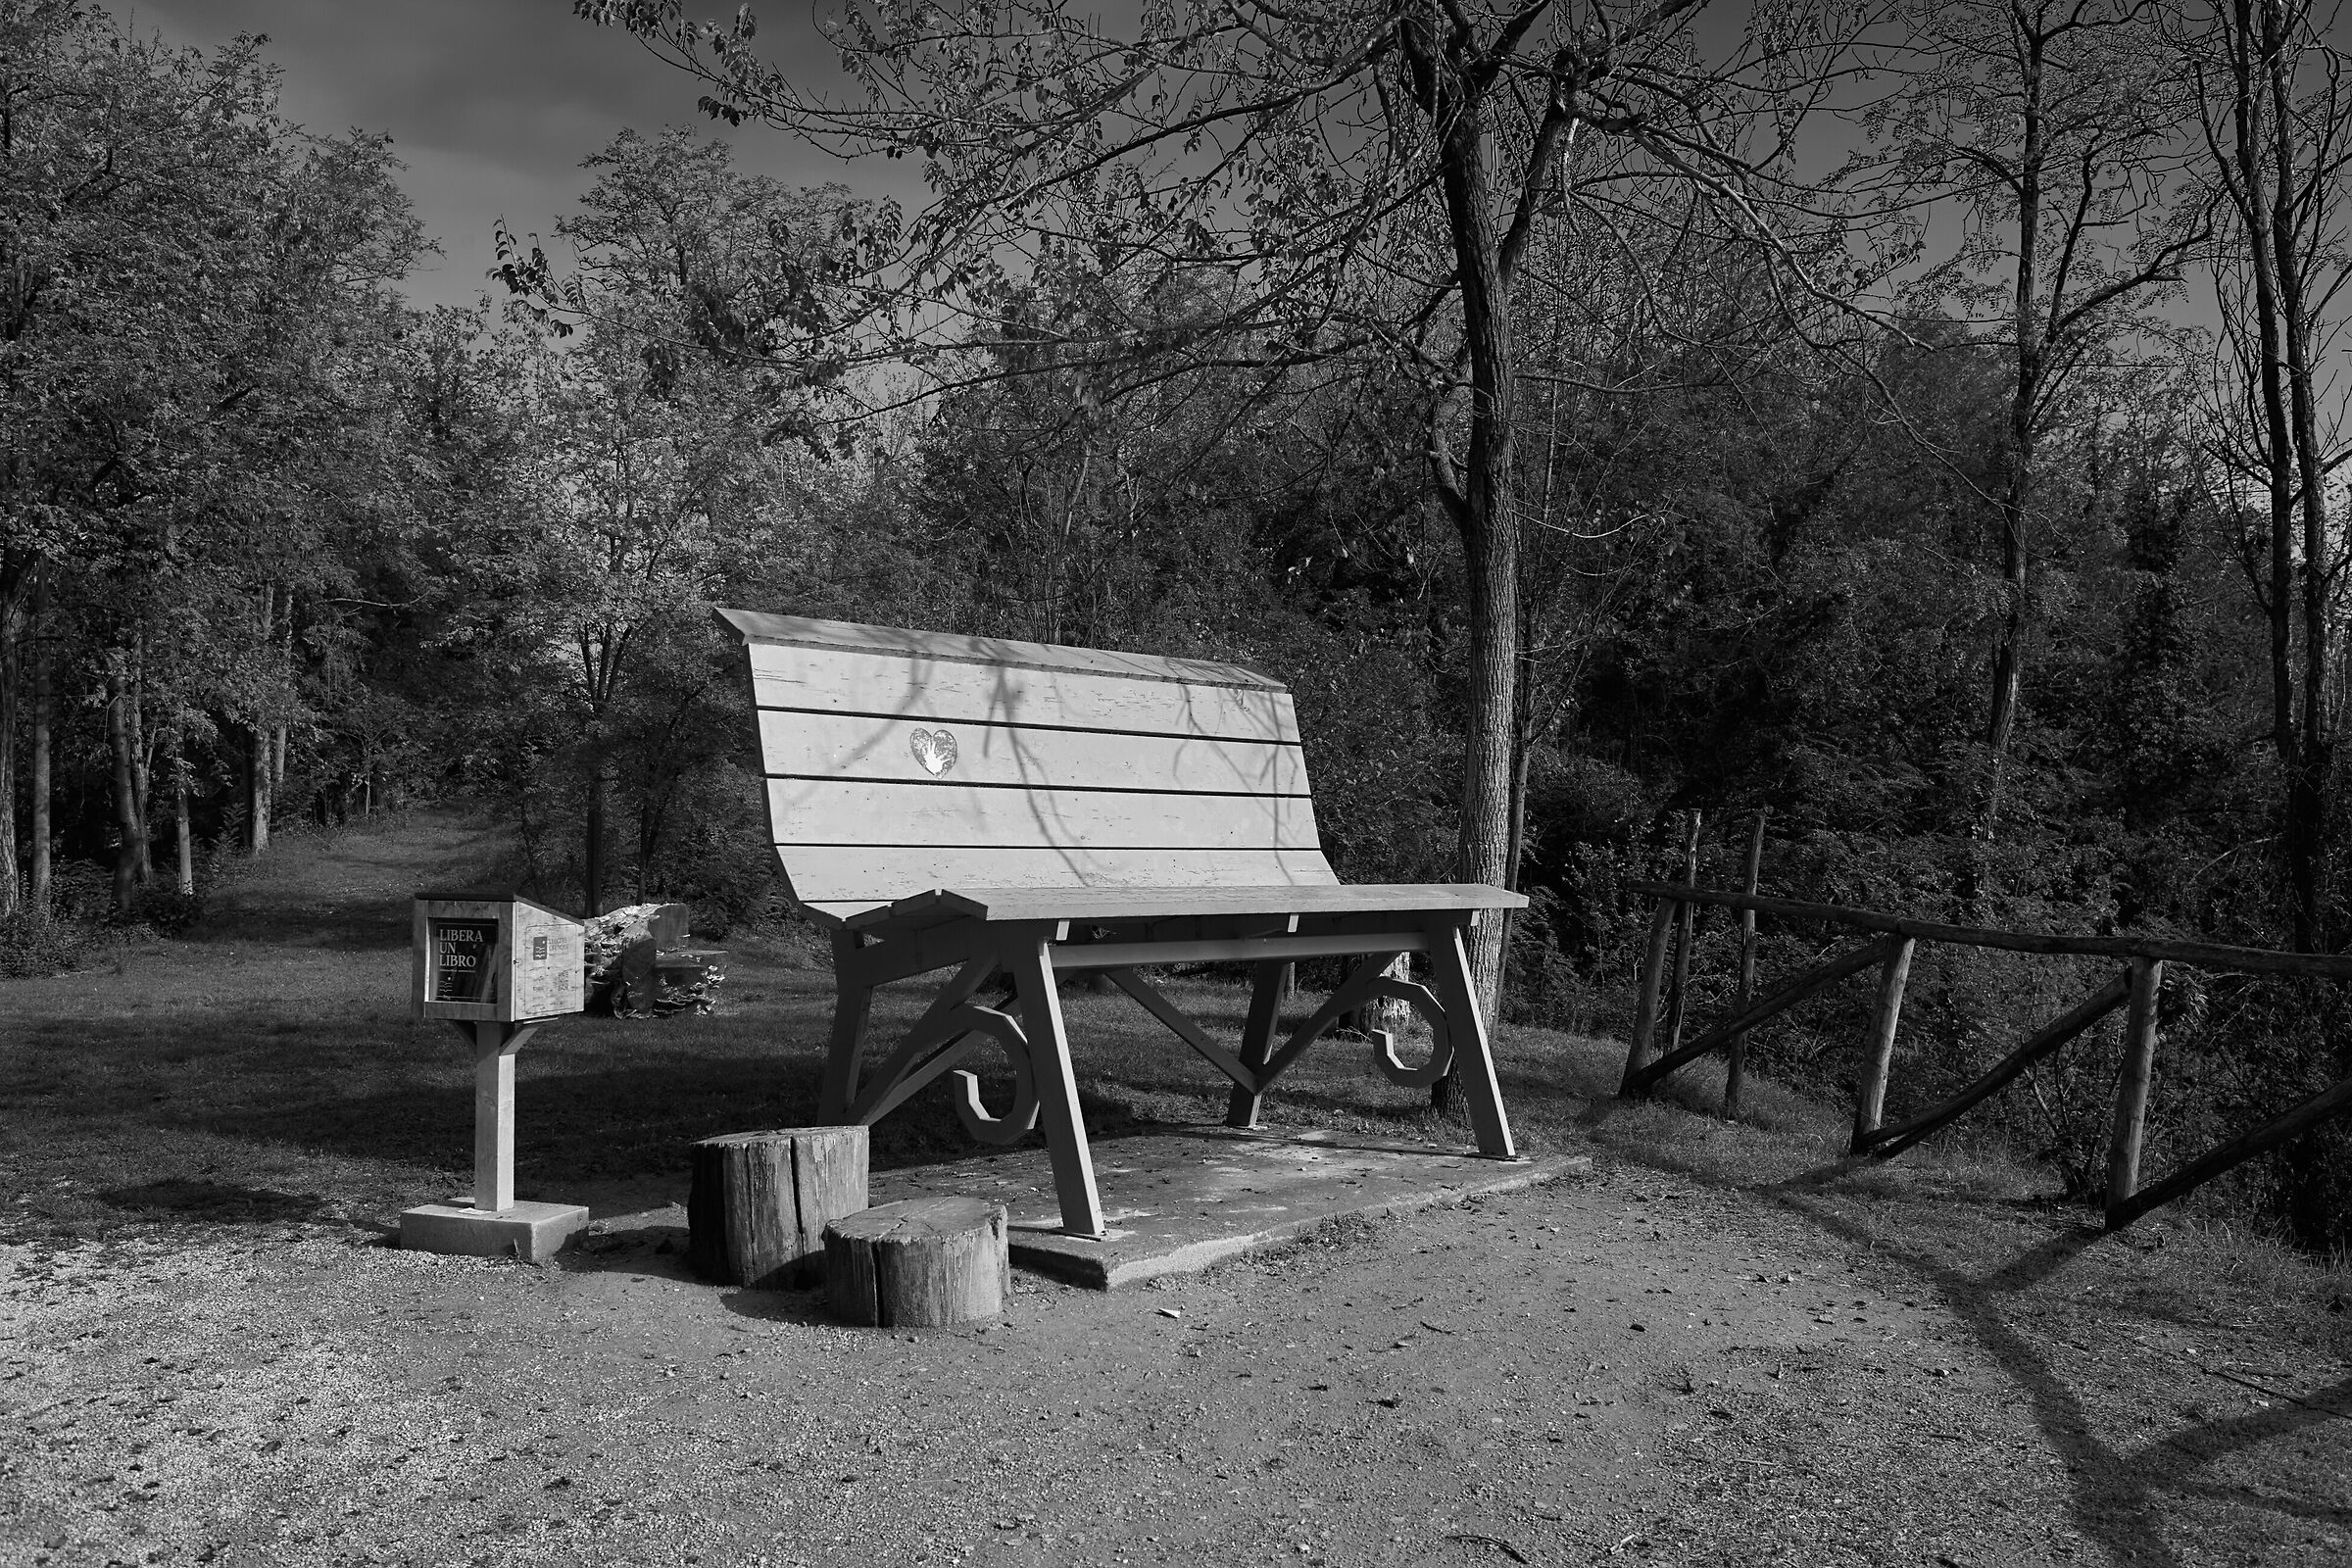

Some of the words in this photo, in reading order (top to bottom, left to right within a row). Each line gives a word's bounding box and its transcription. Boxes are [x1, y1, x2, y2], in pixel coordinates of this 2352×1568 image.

[439, 929, 483, 942] LIBERA
[439, 942, 457, 954] UN
[439, 955, 476, 967] LIBRO
